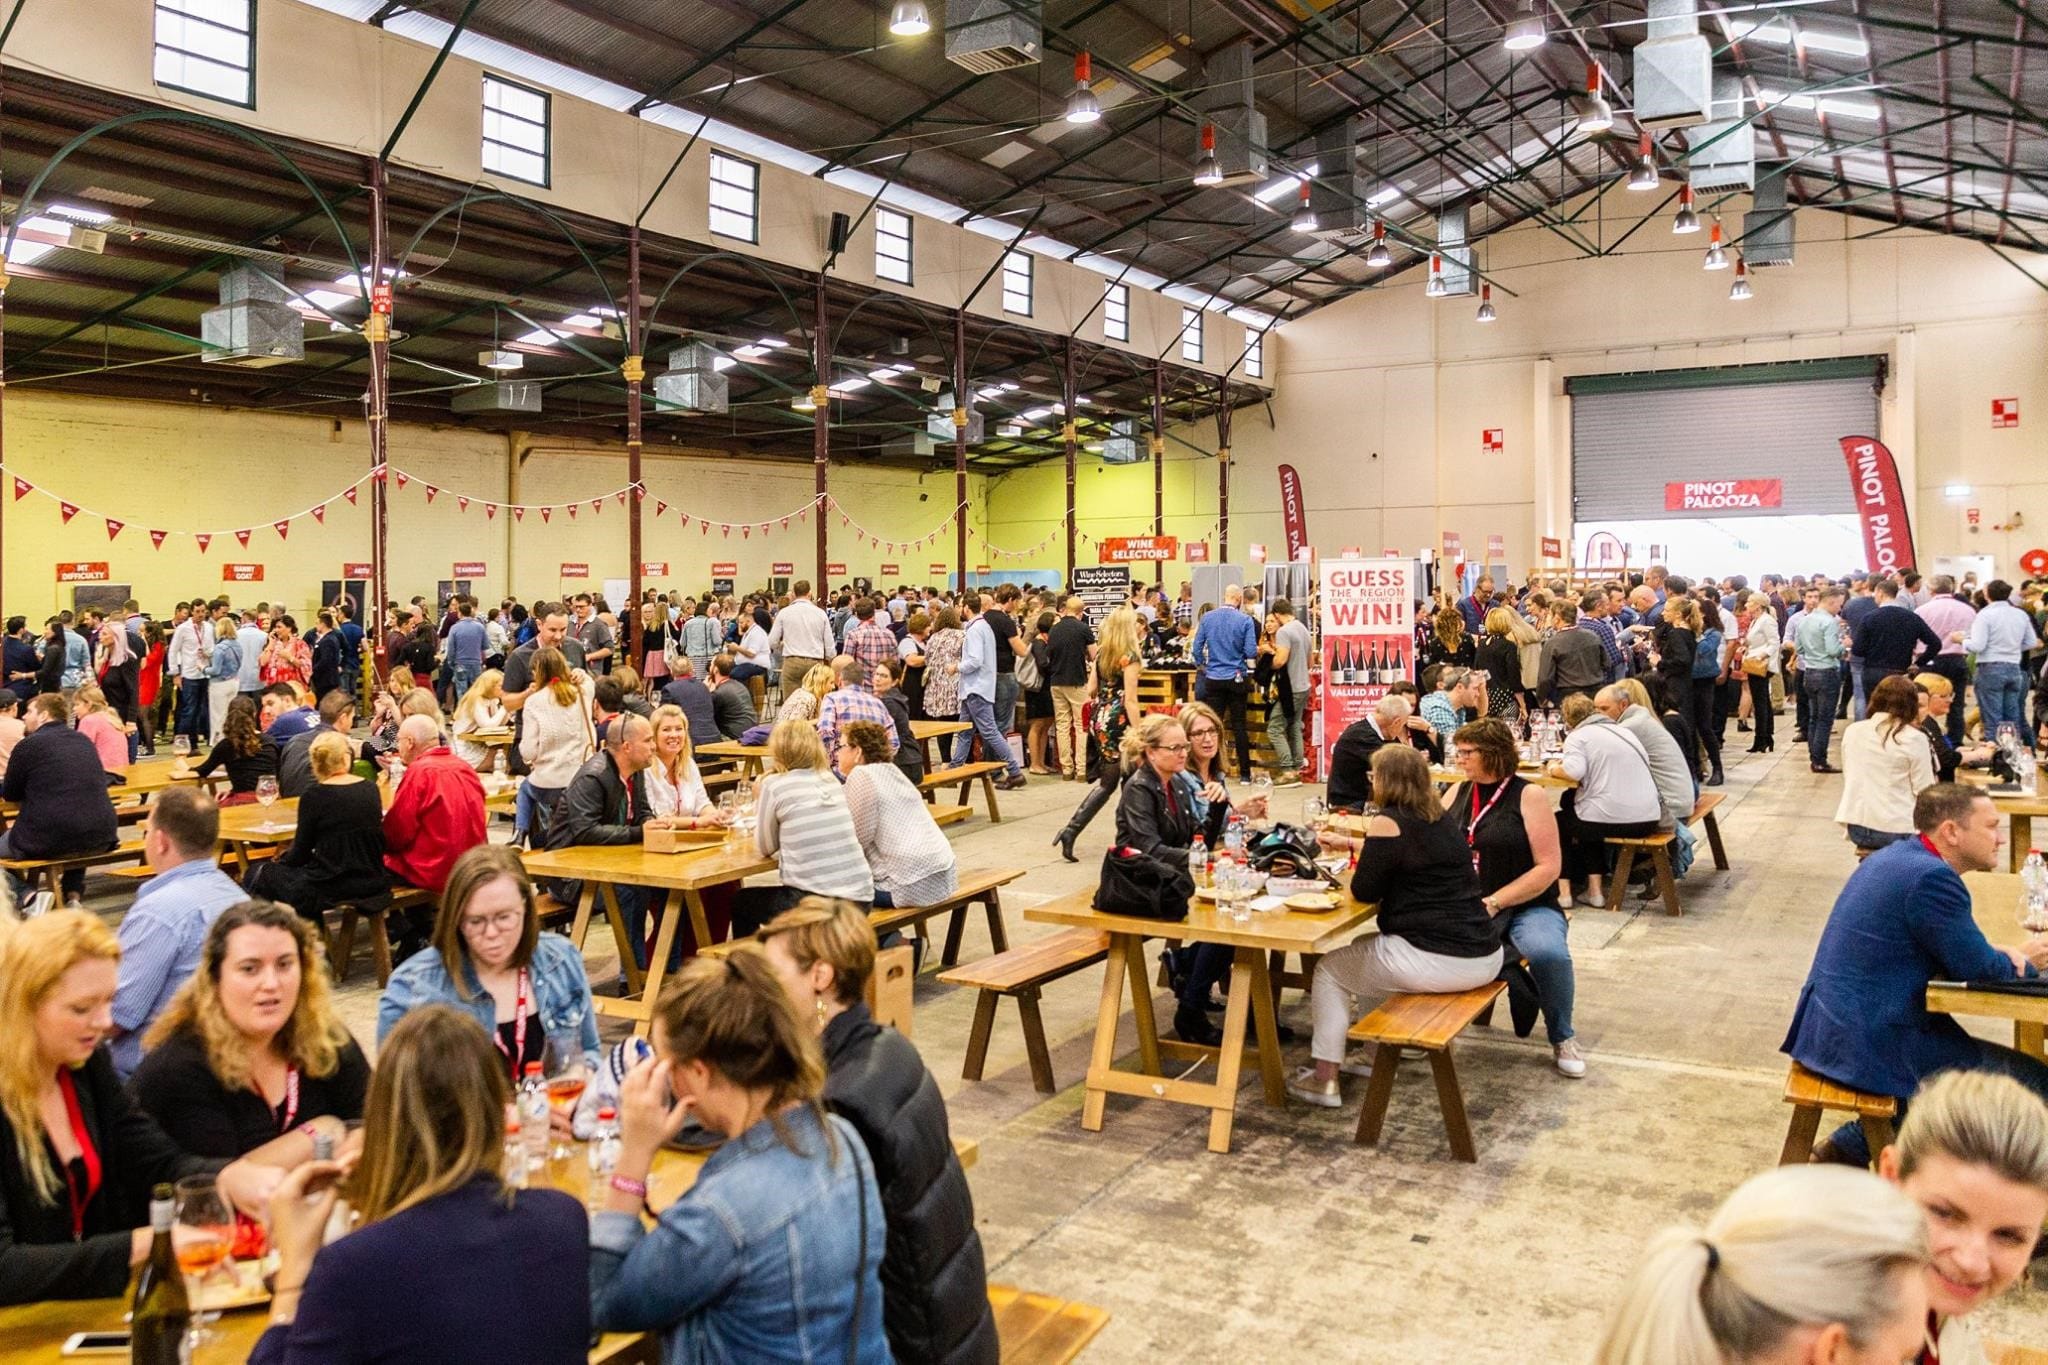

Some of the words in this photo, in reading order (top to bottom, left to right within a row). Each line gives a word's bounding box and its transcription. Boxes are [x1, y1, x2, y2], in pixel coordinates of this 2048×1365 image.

[375, 288, 388, 296] FIRE
[1853, 444, 1886, 506] PINOT
[1684, 481, 1737, 495] PINOT
[1283, 471, 1297, 524] PINOT
[1684, 494, 1761, 509] PALOOZA
[1126, 539, 1154, 549] WINE
[1111, 549, 1170, 560] SELECTORS
[61, 571, 105, 580] DIFFICULTY
[235, 572, 253, 580] GOAT
[1330, 570, 1404, 587] GUESS
[1330, 589, 1351, 597] THE
[1360, 588, 1404, 597] REGION
[1330, 603, 1403, 625] WIN!
[1330, 688, 1367, 697] VALUED
[1368, 687, 1380, 696] AT
